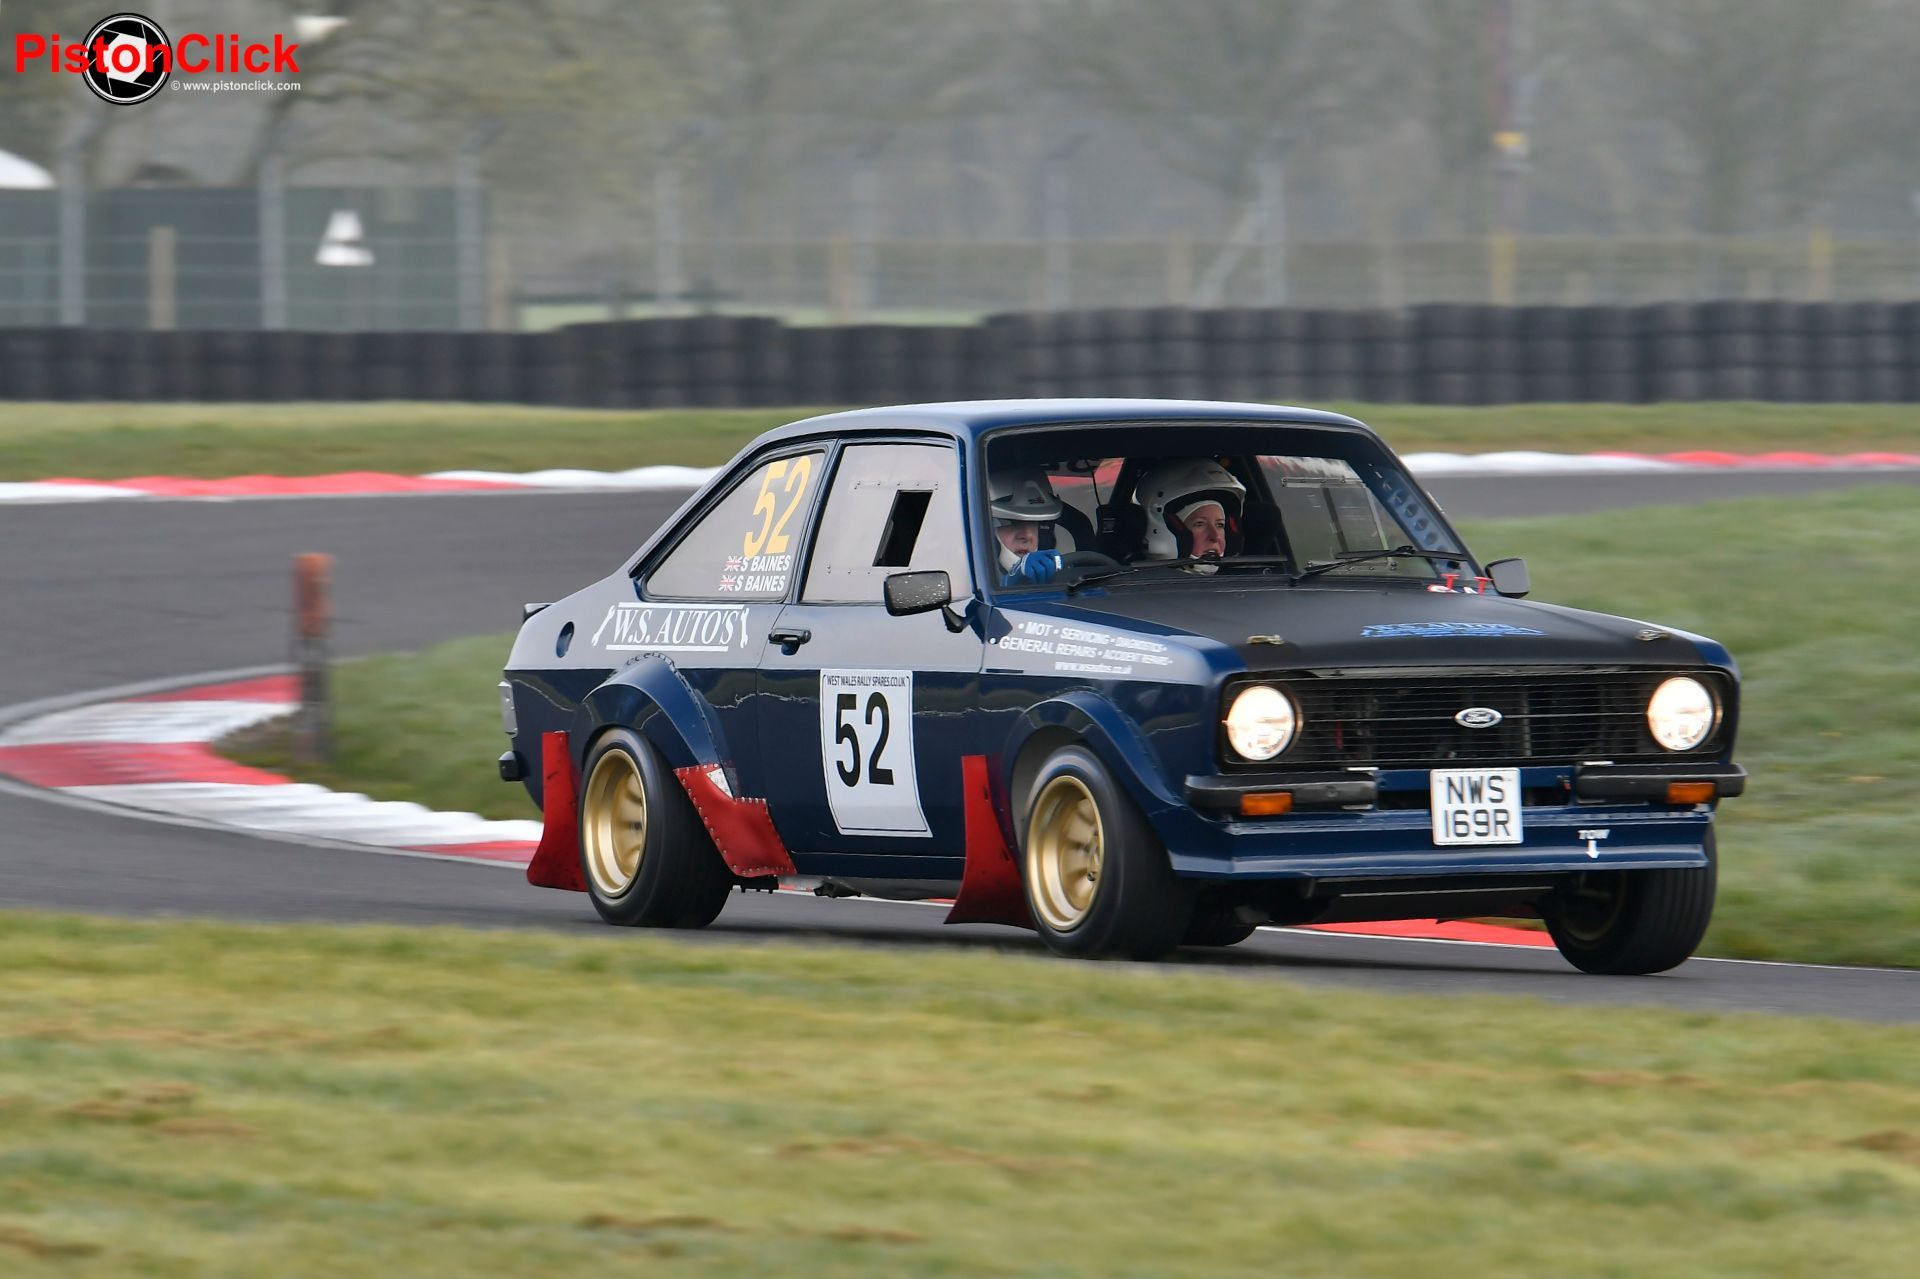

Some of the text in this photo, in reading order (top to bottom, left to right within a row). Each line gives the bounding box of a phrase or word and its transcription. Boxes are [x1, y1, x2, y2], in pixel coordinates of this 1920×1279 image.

[743, 455, 812, 560] 52
[740, 554, 792, 572] S BAINES
[734, 574, 786, 592] S BAINES
[613, 609, 740, 645] W.S. AUTO'S
[1025, 621, 1054, 637] MOT
[999, 635, 1055, 654] GENERAL
[1055, 643, 1098, 658] REPAIRS
[826, 675, 840, 686] WEST
[841, 675, 857, 686] WALES
[857, 676, 871, 687] RALLY
[835, 691, 895, 788] 52
[1446, 775, 1505, 804] NWS
[1444, 808, 1512, 838] 169R
[1577, 829, 1610, 840] TOW
